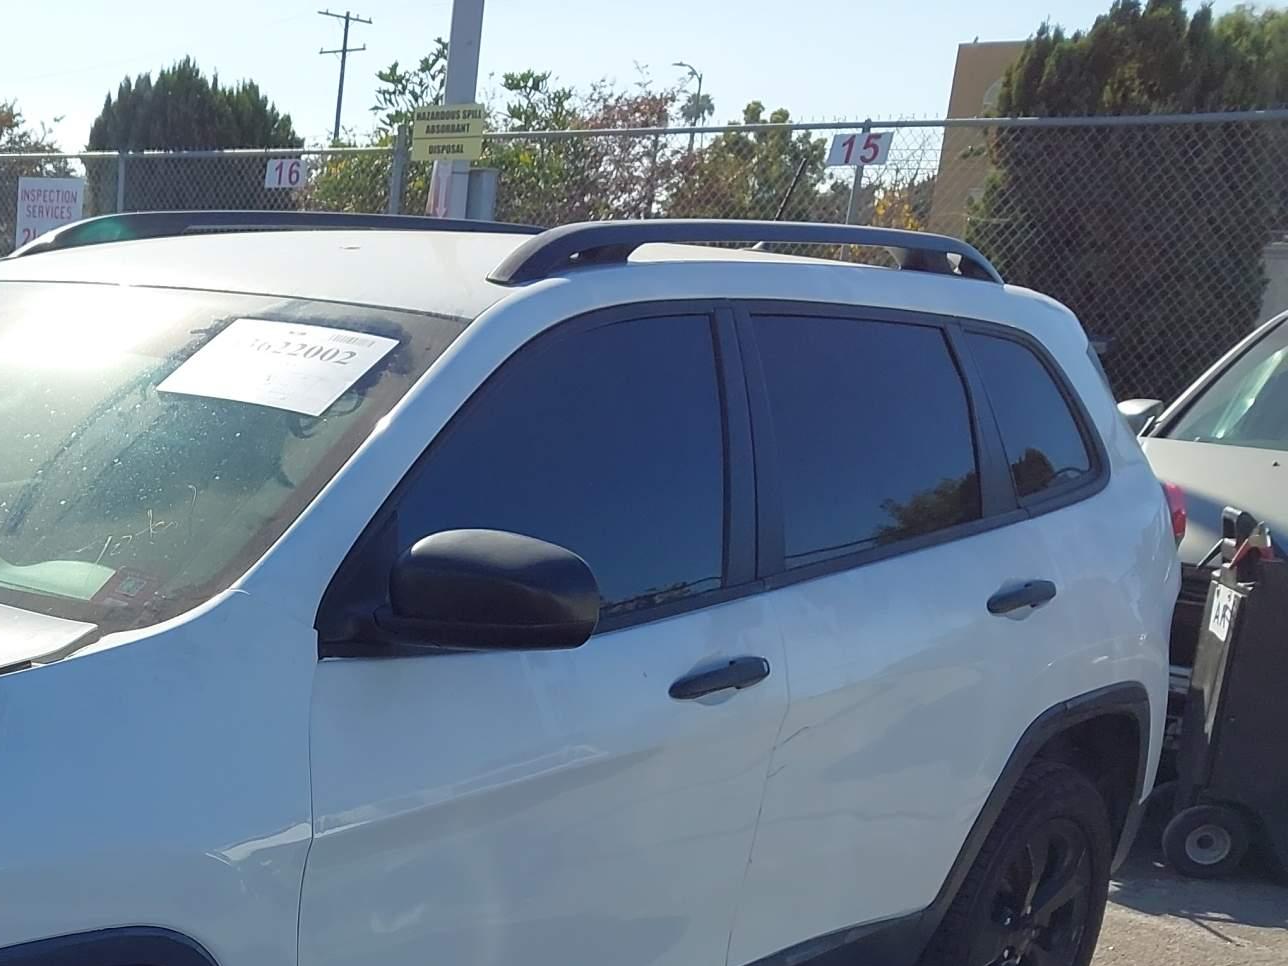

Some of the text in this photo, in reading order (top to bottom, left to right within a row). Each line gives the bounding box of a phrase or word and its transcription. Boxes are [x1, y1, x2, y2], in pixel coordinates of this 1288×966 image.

[416, 109, 482, 121] HAZARDOUS SPILL
[428, 144, 465, 155] DISPOSAL
[841, 133, 882, 164] 15
[274, 160, 301, 186] 16
[20, 188, 79, 204] INSPECTION
[24, 203, 73, 221] SERVICES
